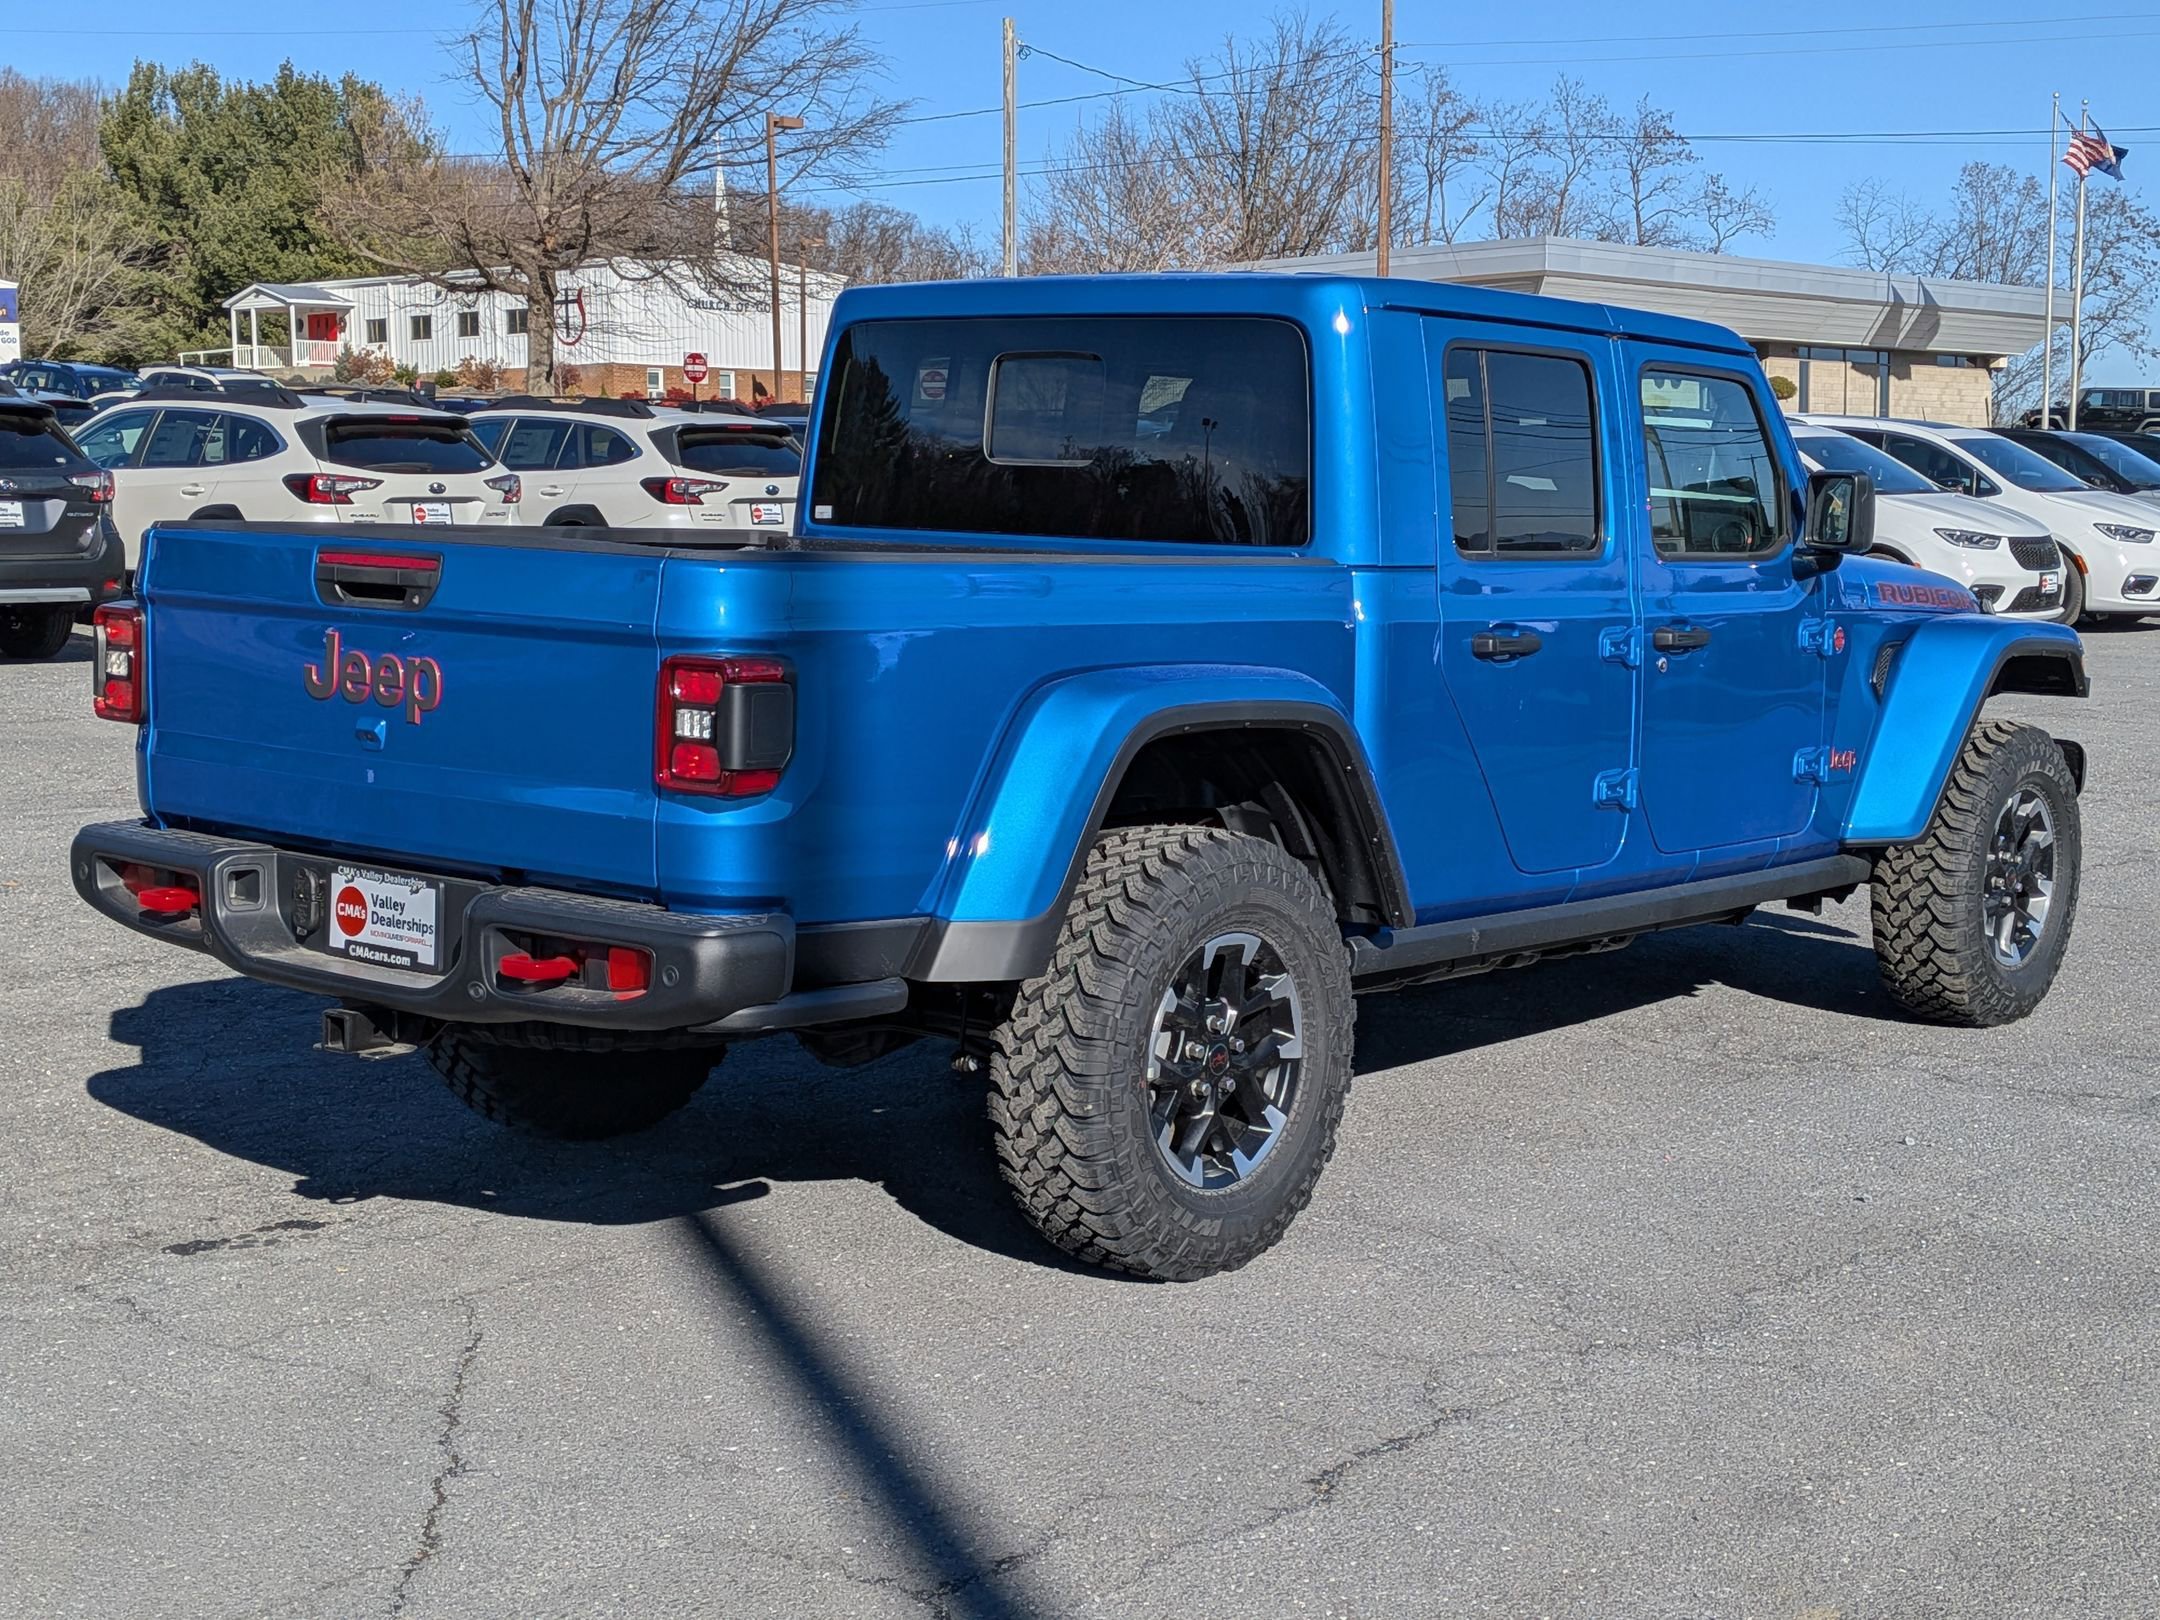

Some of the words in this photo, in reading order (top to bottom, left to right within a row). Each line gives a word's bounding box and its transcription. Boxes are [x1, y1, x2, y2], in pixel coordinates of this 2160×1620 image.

[1879, 583, 1976, 610] RUBICON
[303, 631, 443, 726] Jeep
[337, 865, 361, 879] CMA's
[360, 869, 384, 885] Valley
[384, 873, 427, 891] Dealerships
[337, 902, 366, 920] CMA's
[370, 893, 406, 915] Valley
[370, 911, 434, 937] Dealerships
[348, 944, 411, 967] CMAcars.com
